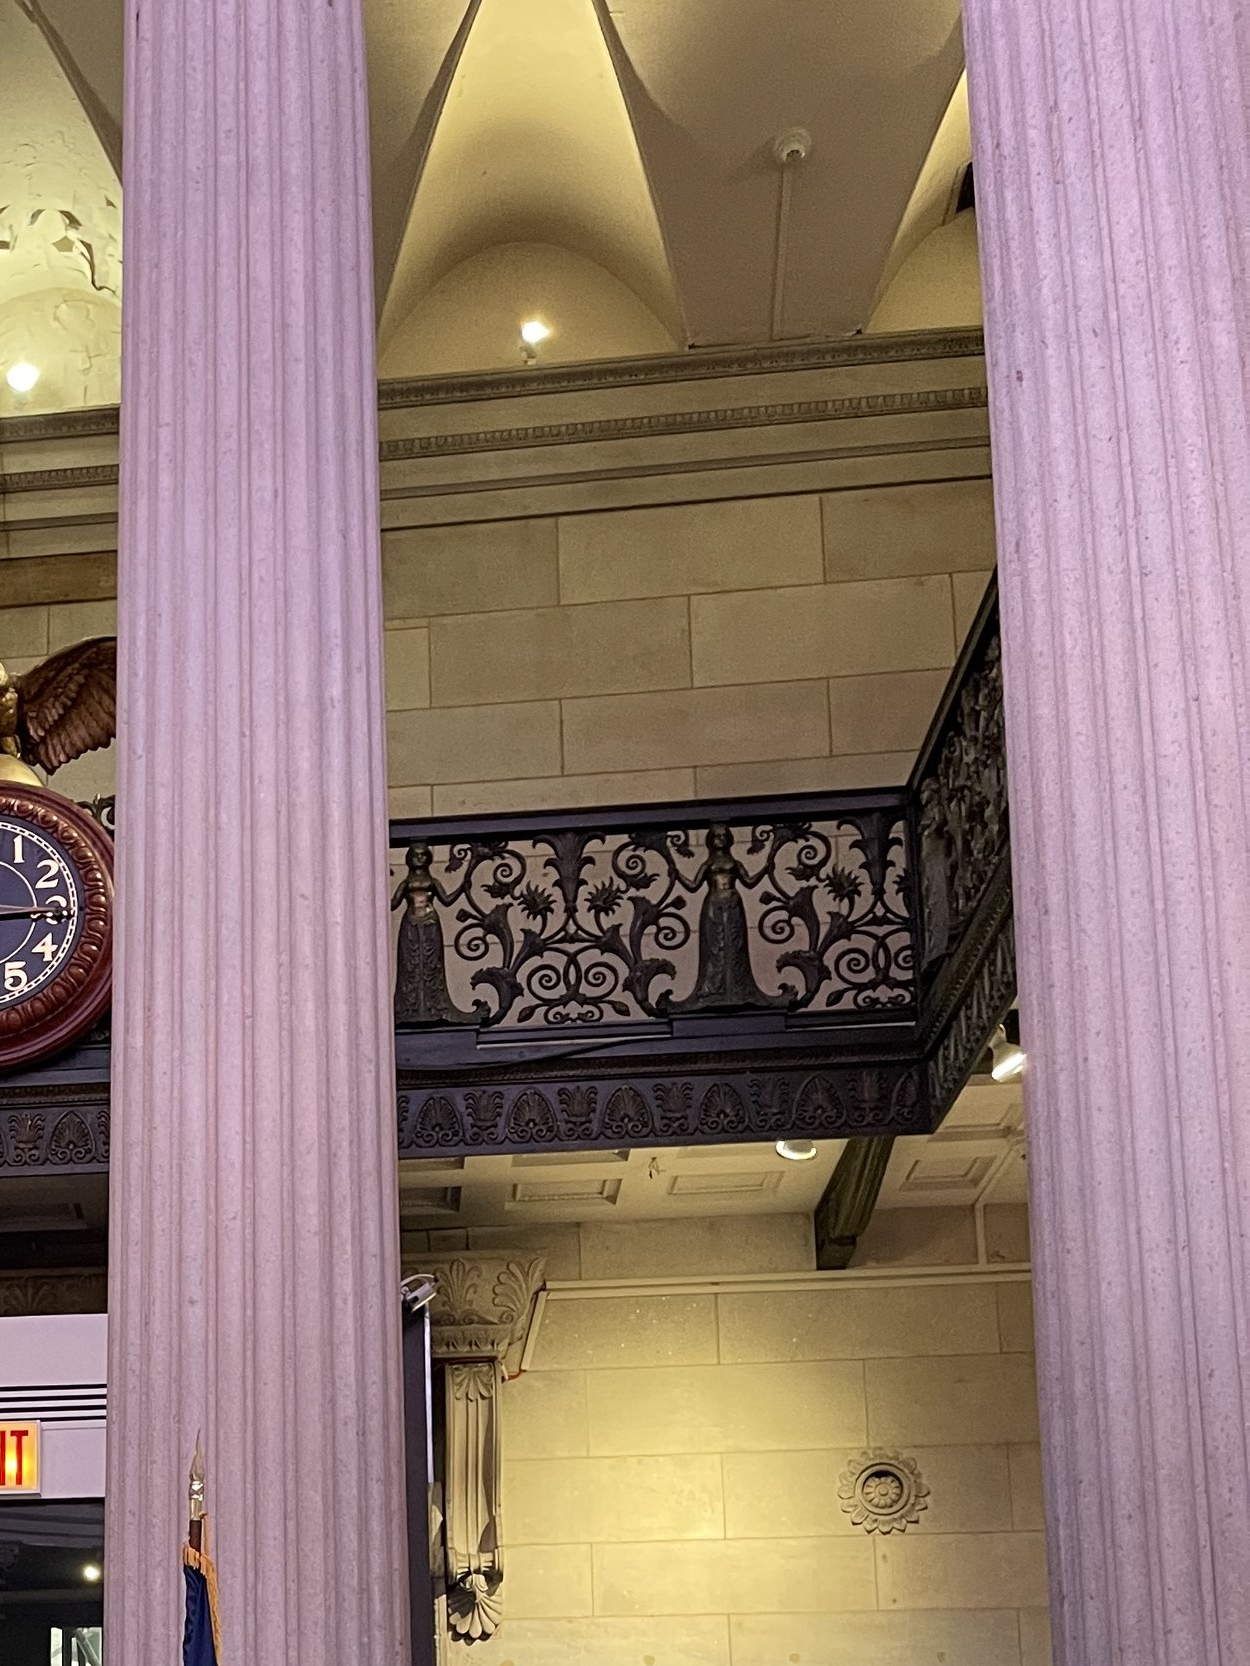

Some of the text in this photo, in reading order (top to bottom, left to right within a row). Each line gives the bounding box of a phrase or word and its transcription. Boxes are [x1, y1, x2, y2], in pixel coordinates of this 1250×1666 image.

[13, 835, 25, 863] 1
[35, 860, 59, 888] 2
[31, 932, 58, 962] 4
[4, 961, 28, 991] 5
